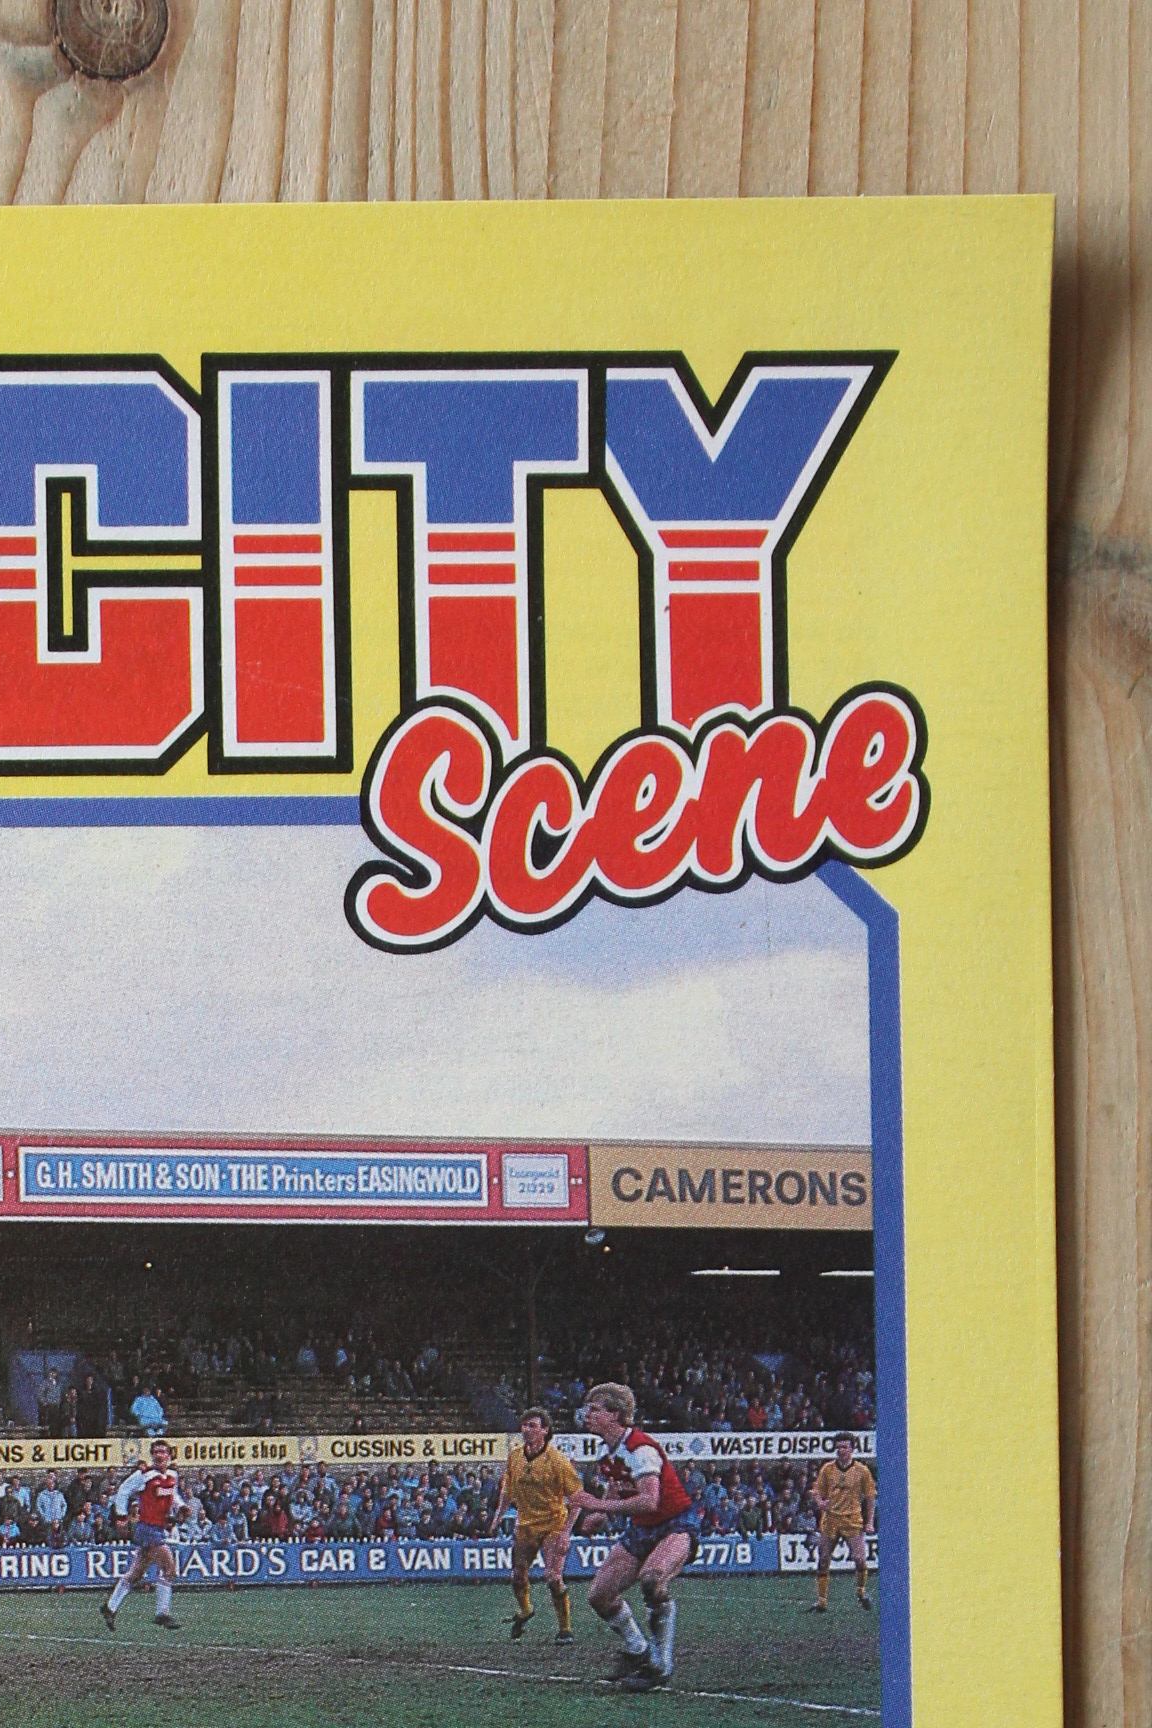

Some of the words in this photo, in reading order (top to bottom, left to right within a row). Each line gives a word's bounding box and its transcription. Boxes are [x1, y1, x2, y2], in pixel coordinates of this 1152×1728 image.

[344, 681, 931, 955] Scene
[81, 1162, 151, 1190] SMITH
[155, 1162, 173, 1190] &
[272, 1165, 354, 1193] Printers
[358, 1165, 480, 1194] EASINGWOLD
[611, 1166, 867, 1207] CAMERONS
[31, 1445, 46, 1462] &
[52, 1444, 111, 1463] LIGHT
[184, 1441, 245, 1460] electric
[251, 1441, 288, 1459] shop
[331, 1440, 415, 1458] CUSSINS
[422, 1440, 436, 1456] &
[443, 1438, 497, 1458] LIGHT
[710, 1436, 773, 1455] WASTE
[777, 1435, 872, 1454] DISPOAL
[0, 1554, 70, 1579] RING
[301, 1548, 356, 1572] CAR
[369, 1548, 386, 1571] &
[398, 1546, 450, 1570] VAN
